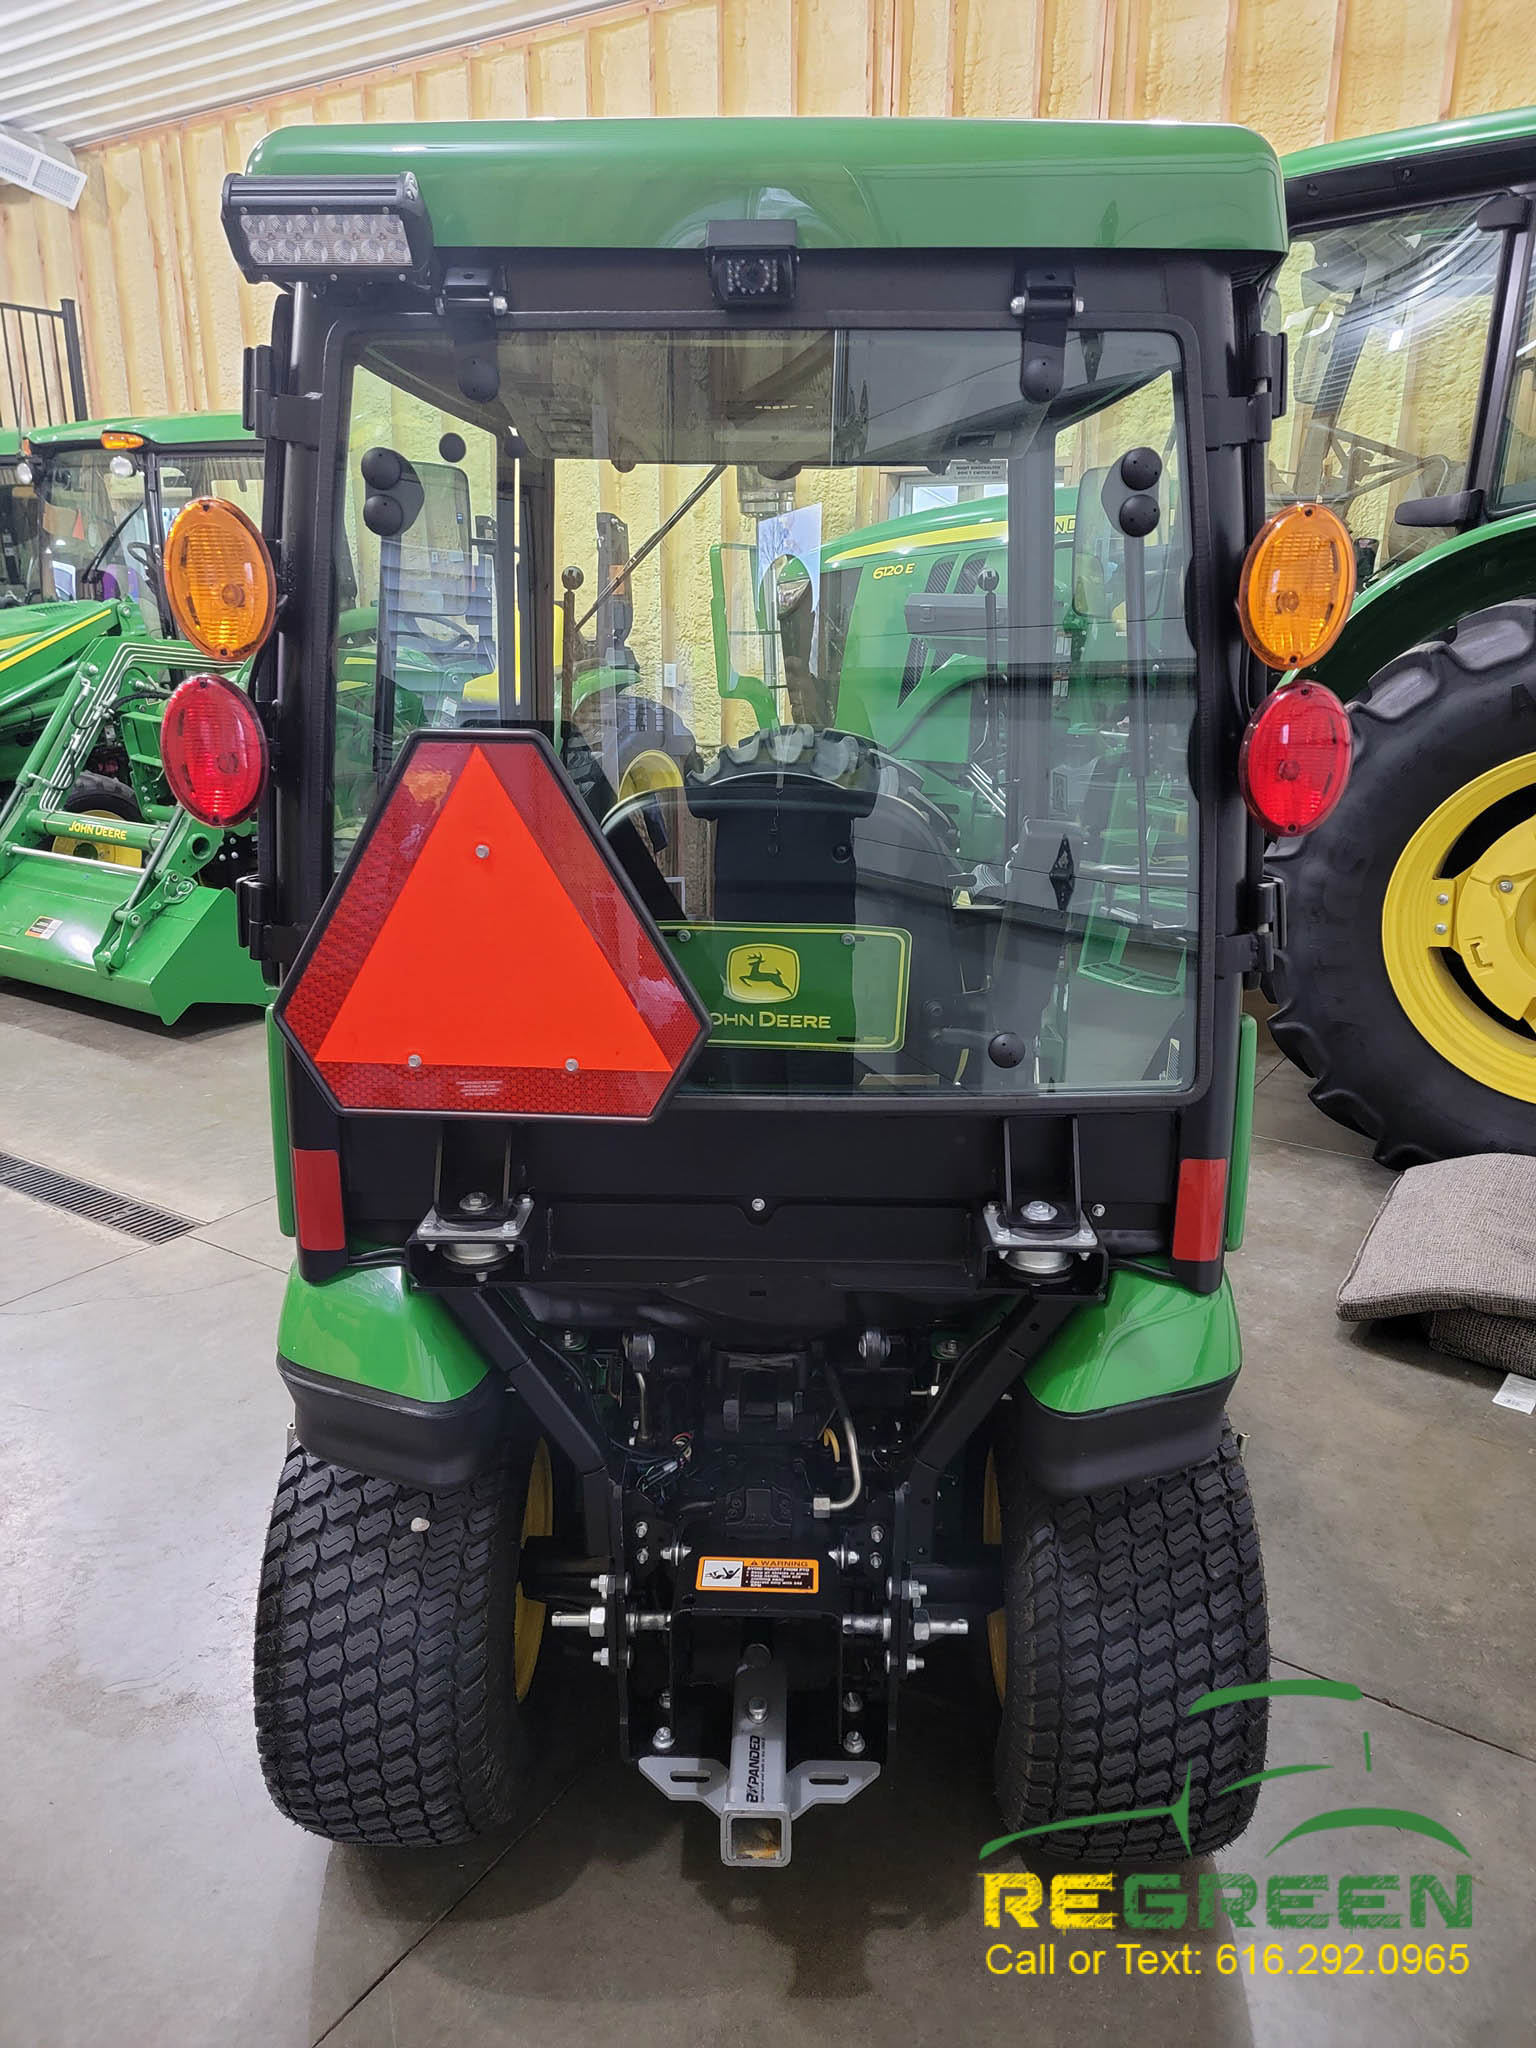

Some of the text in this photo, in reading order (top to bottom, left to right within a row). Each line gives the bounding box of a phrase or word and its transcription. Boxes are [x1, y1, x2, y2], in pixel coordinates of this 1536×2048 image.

[872, 563, 916, 580] 6120 E
[68, 821, 128, 841] JOHN DEERE
[709, 1011, 832, 1029] OHN DEERE
